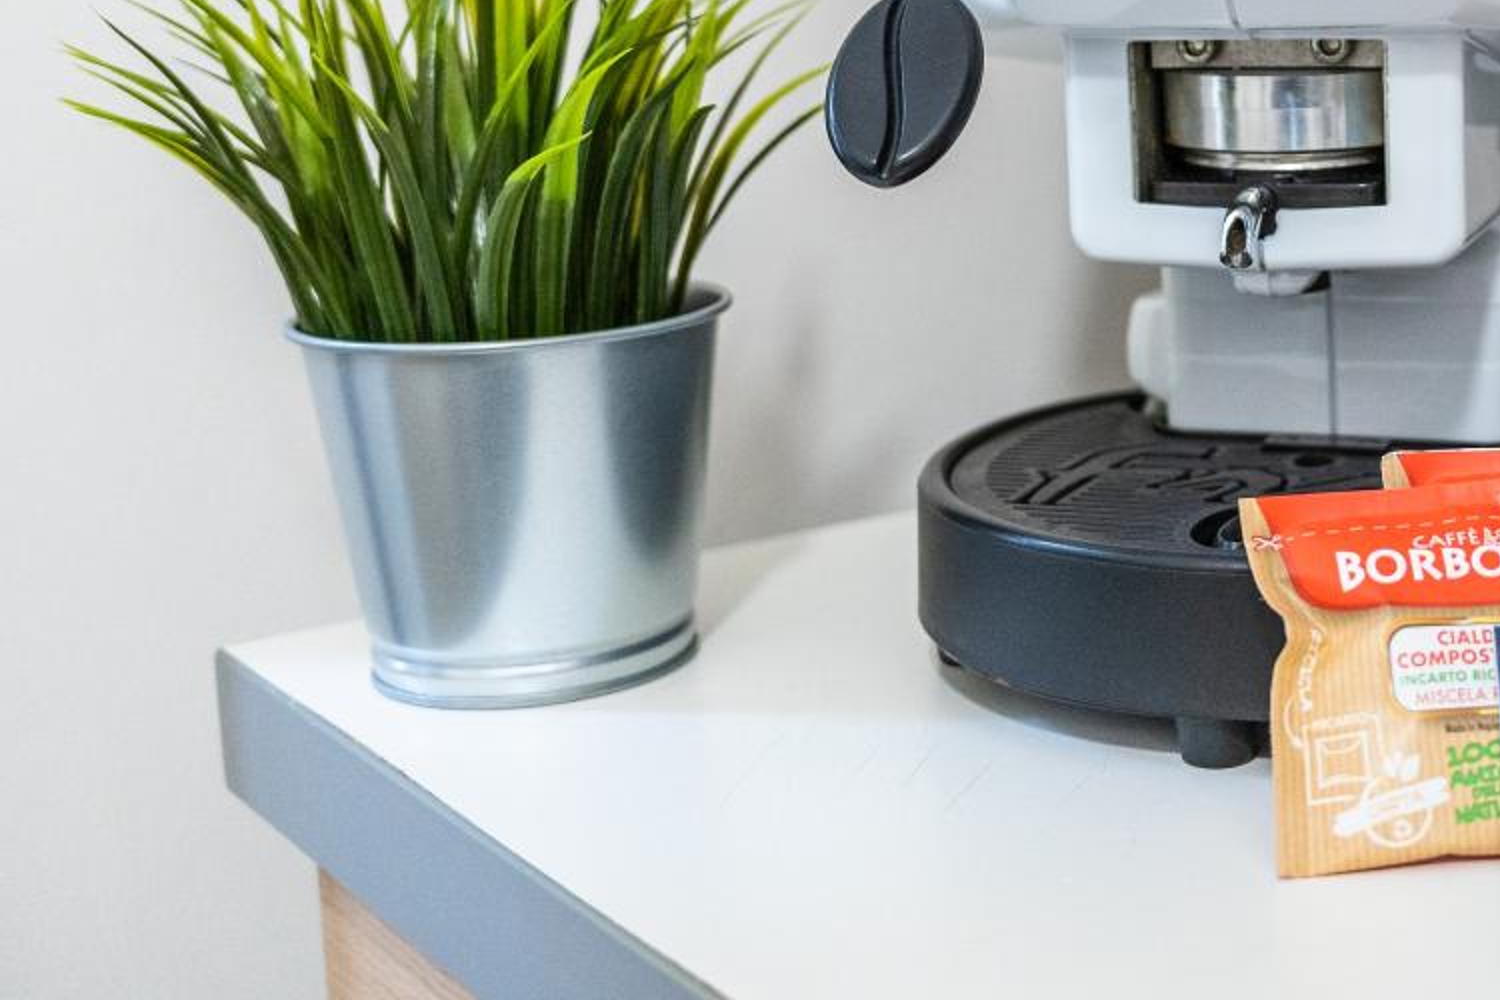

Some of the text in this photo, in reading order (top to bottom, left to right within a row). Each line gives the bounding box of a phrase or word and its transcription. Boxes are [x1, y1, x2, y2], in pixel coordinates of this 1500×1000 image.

[1437, 628, 1494, 646] CIALD
[1397, 647, 1495, 669] COMPOS
[1472, 667, 1497, 682] RIC
